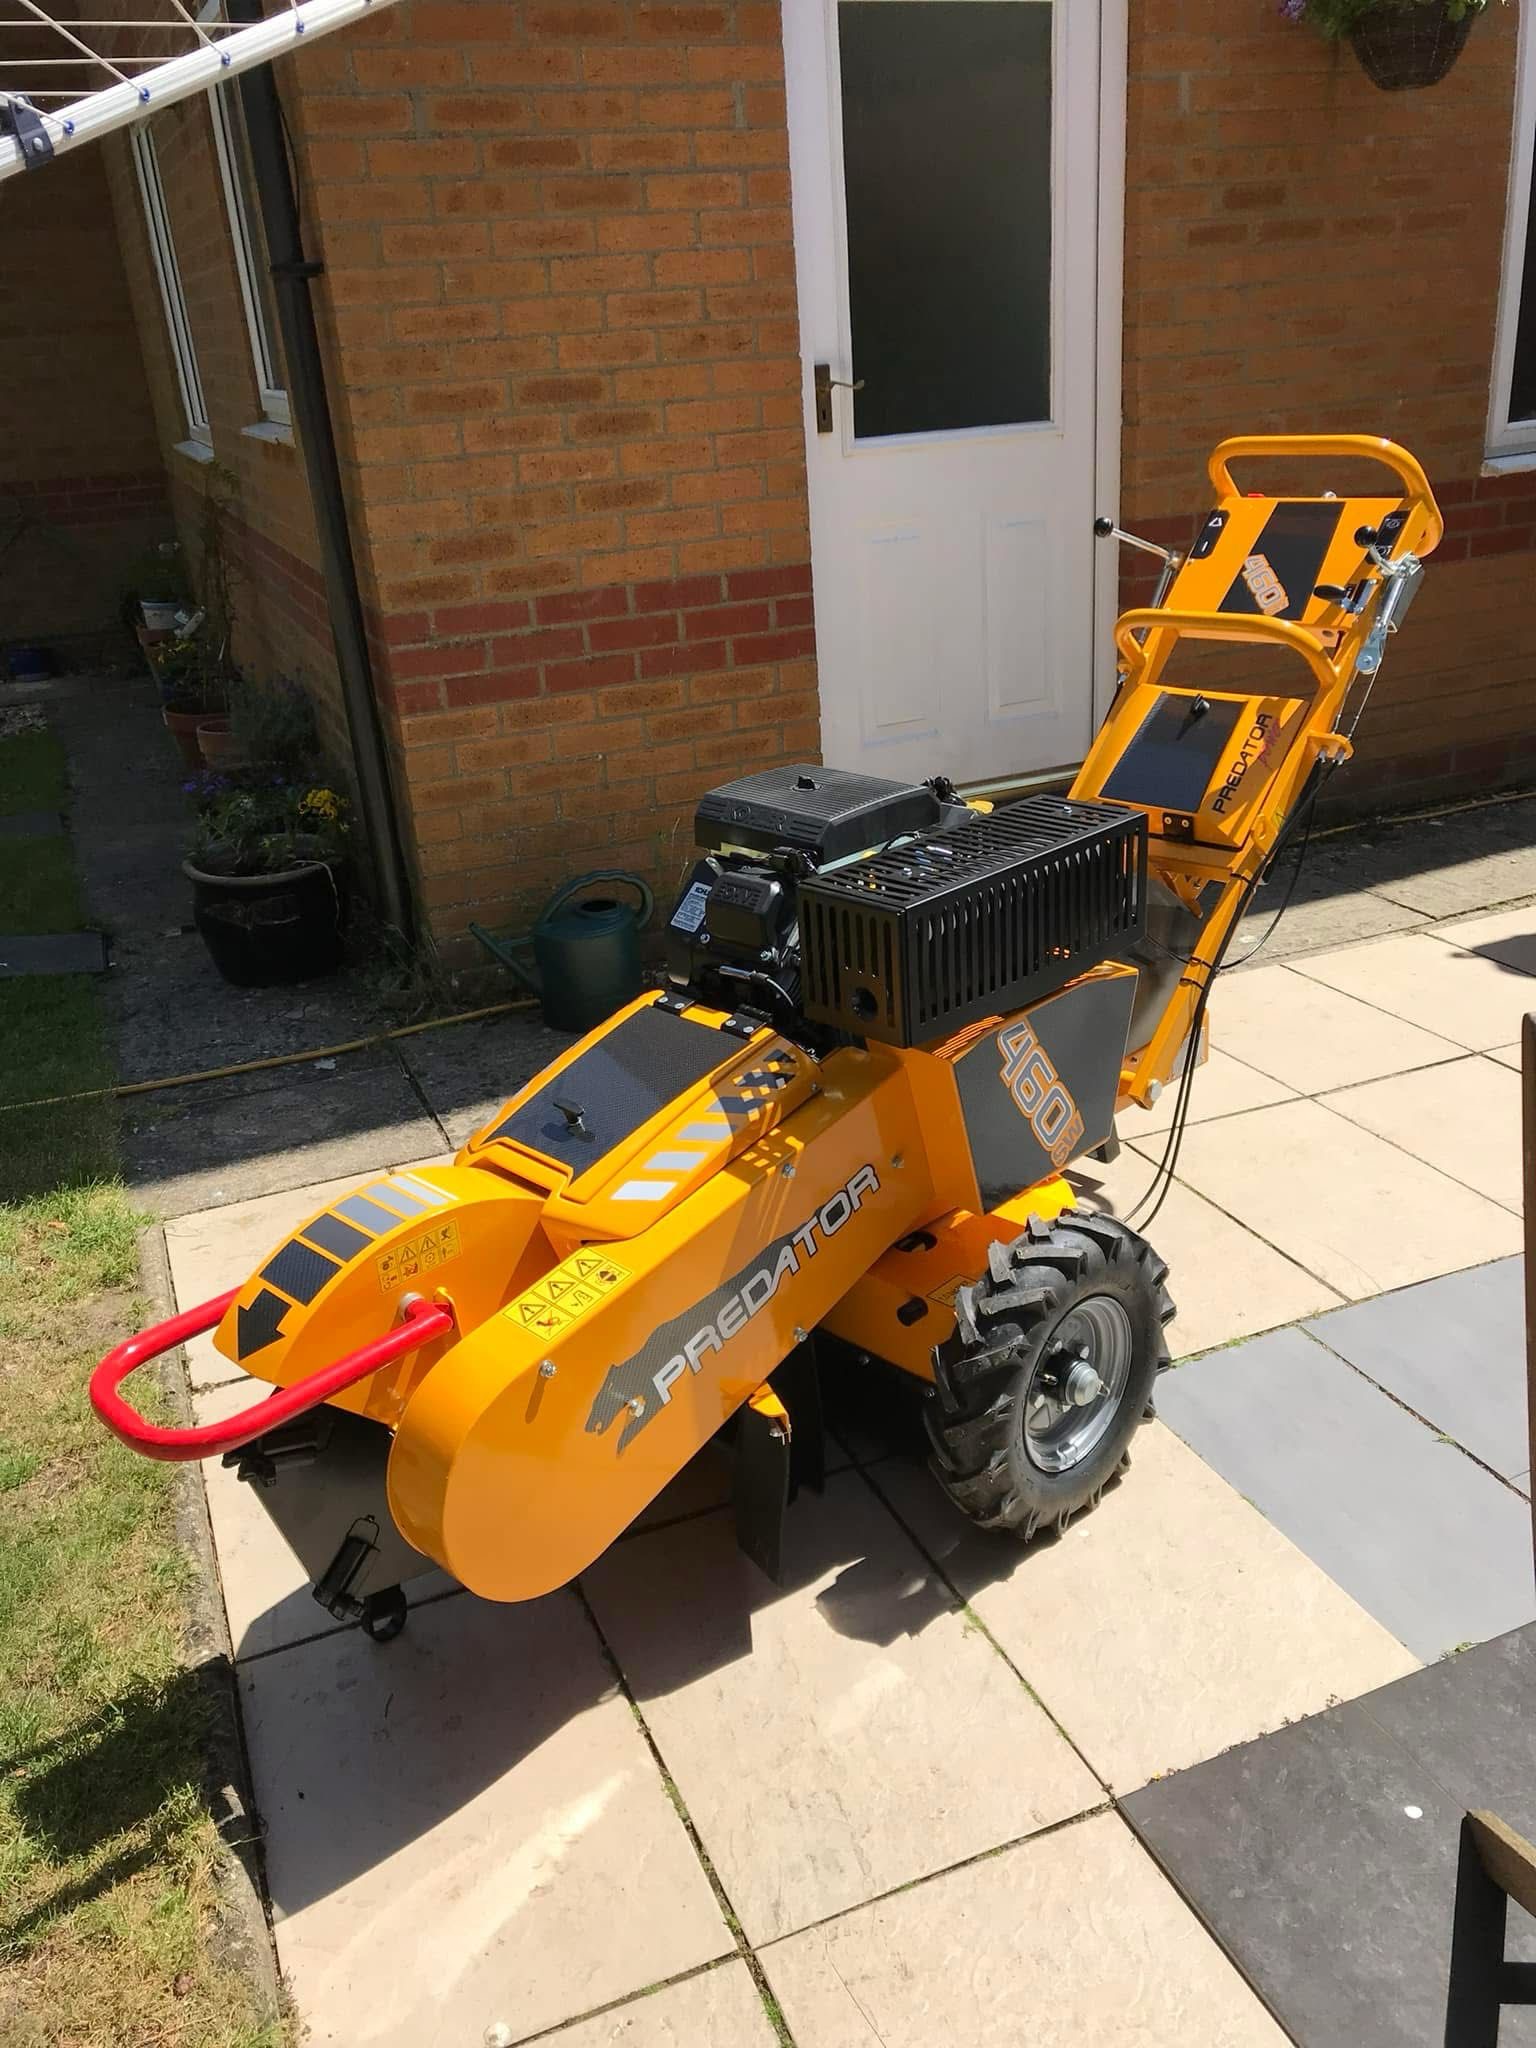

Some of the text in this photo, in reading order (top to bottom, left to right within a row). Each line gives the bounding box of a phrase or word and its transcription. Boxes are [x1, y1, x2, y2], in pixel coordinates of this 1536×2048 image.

[1242, 556, 1283, 609] 460
[1211, 713, 1273, 815] PREDATOR
[998, 1021, 1074, 1148] 460
[651, 1162, 881, 1405] PREDATOR
